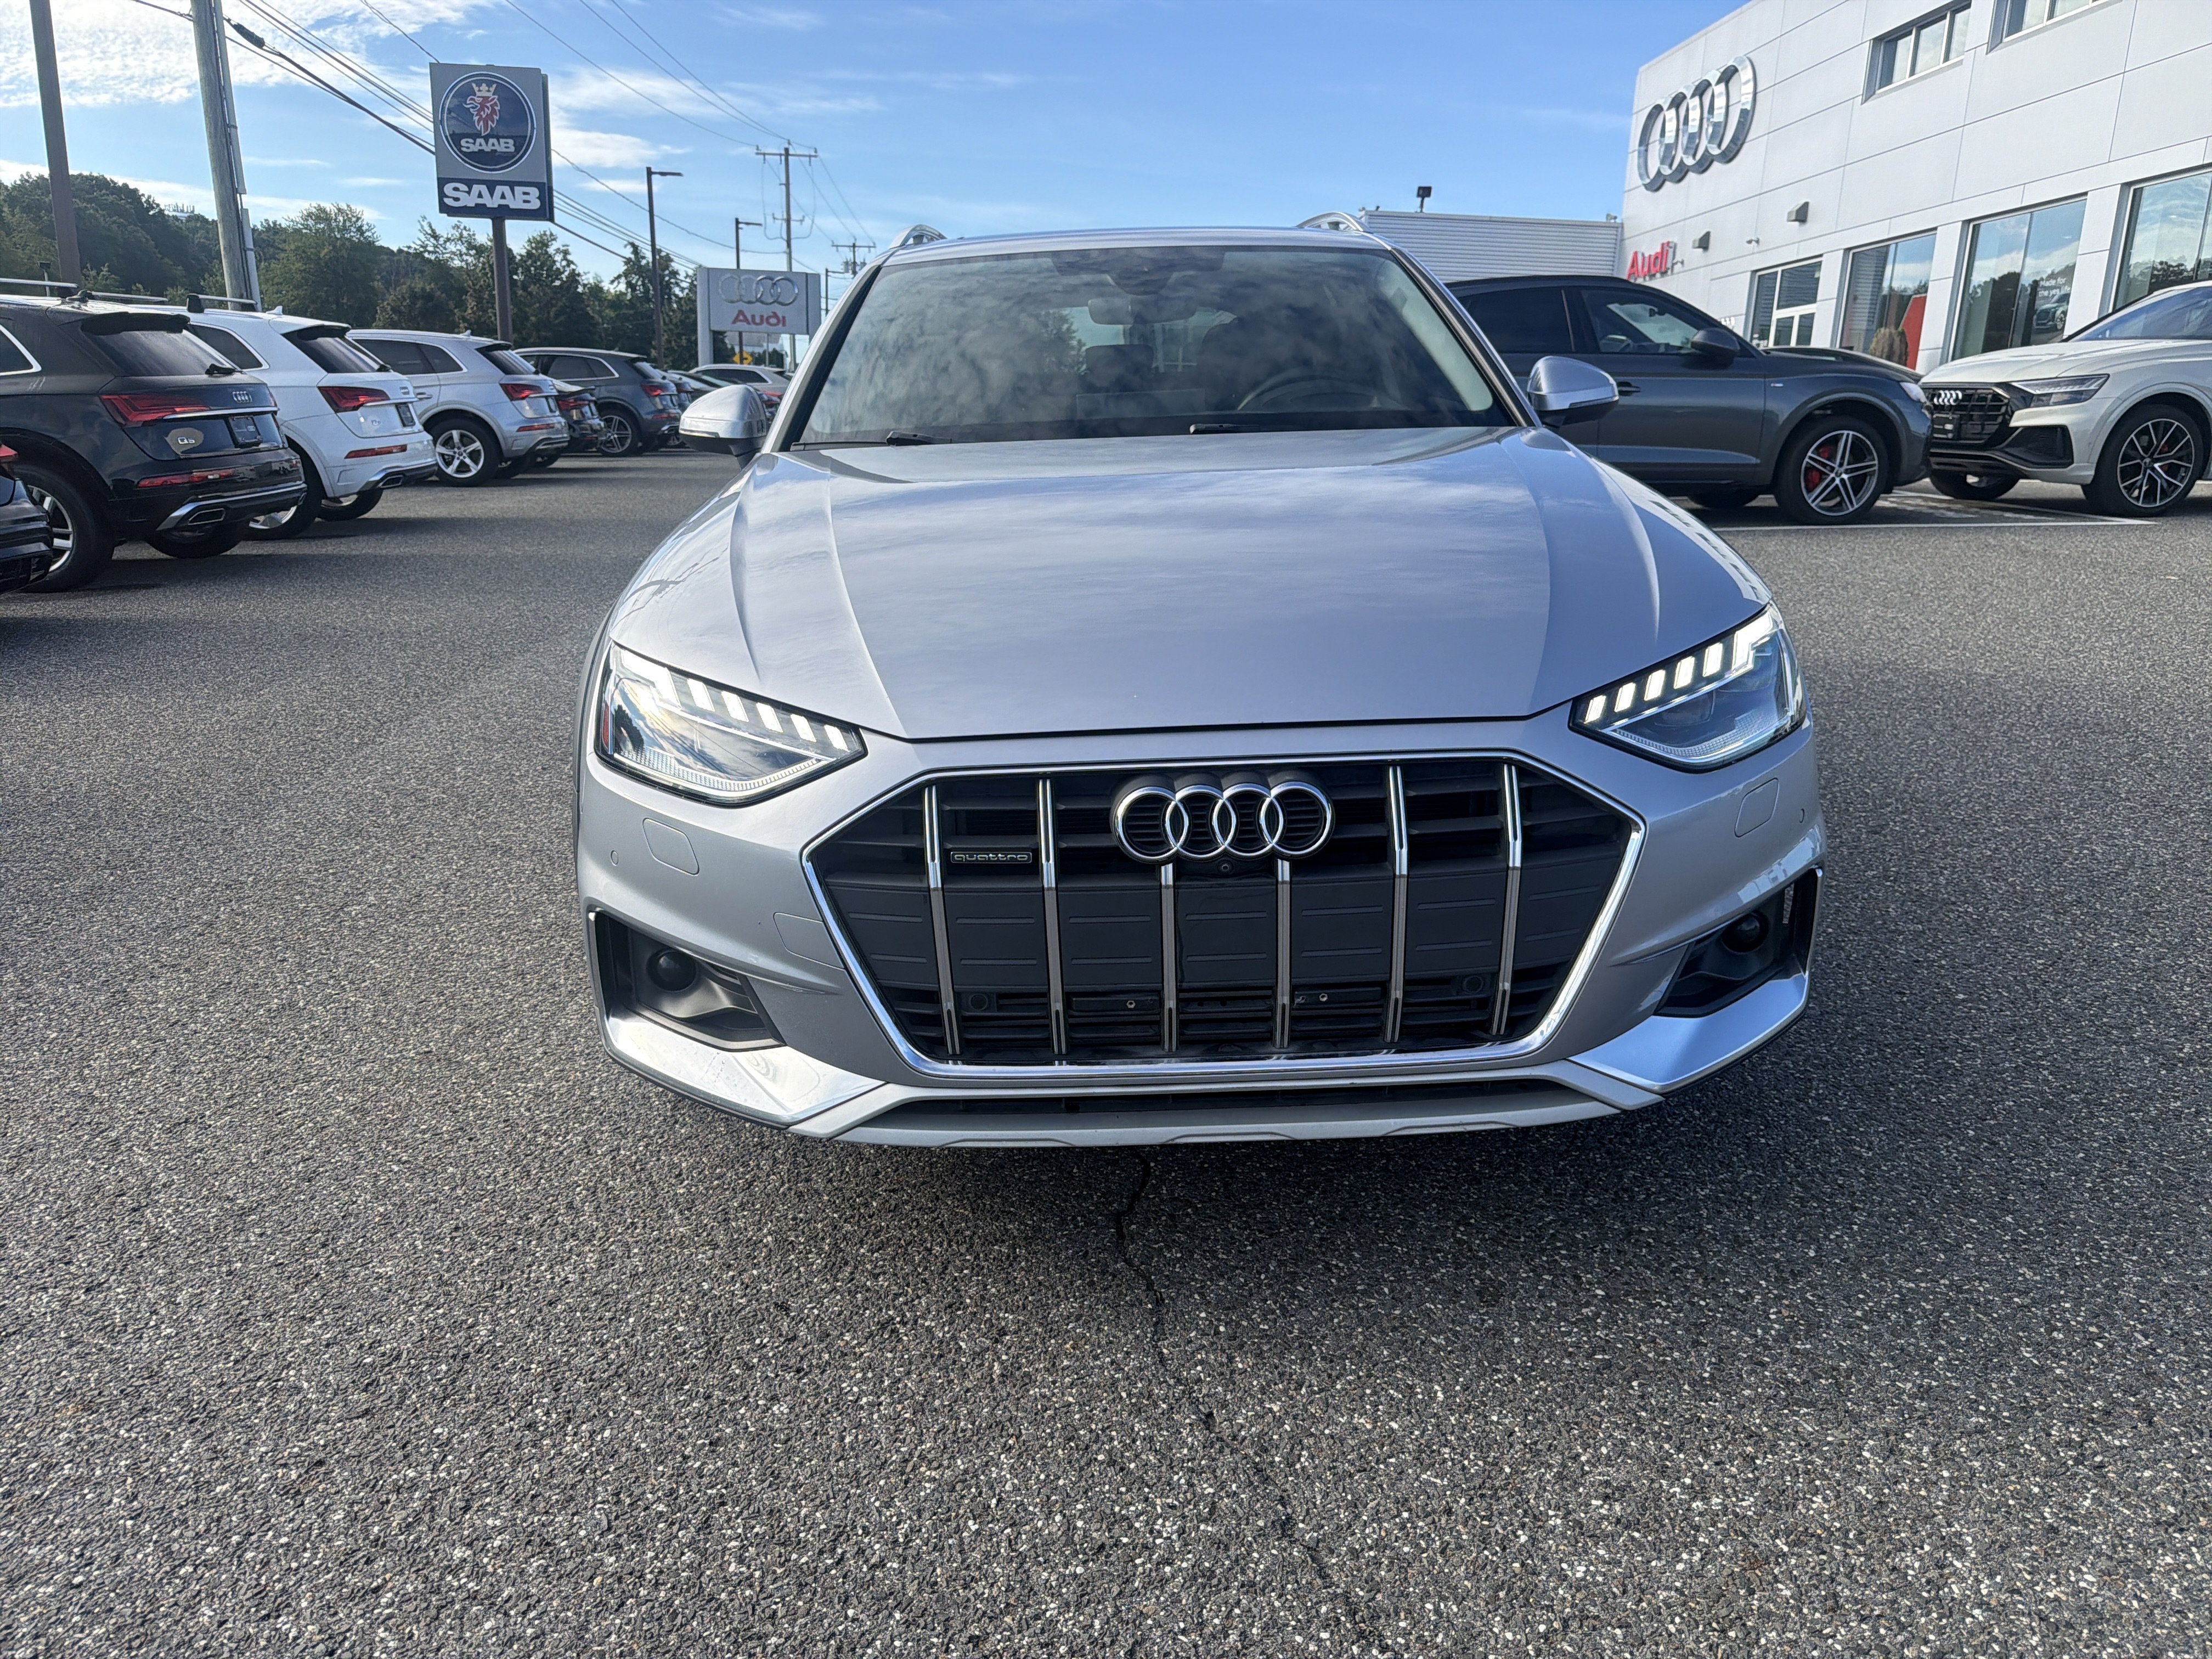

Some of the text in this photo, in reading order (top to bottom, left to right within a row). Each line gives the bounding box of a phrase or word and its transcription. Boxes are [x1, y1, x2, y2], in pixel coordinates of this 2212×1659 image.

[460, 138, 515, 152] SAAB
[443, 182, 541, 209] SAAB
[1626, 241, 1670, 280] Audi
[731, 309, 787, 327] Audi
[955, 854, 1028, 862] quattro
